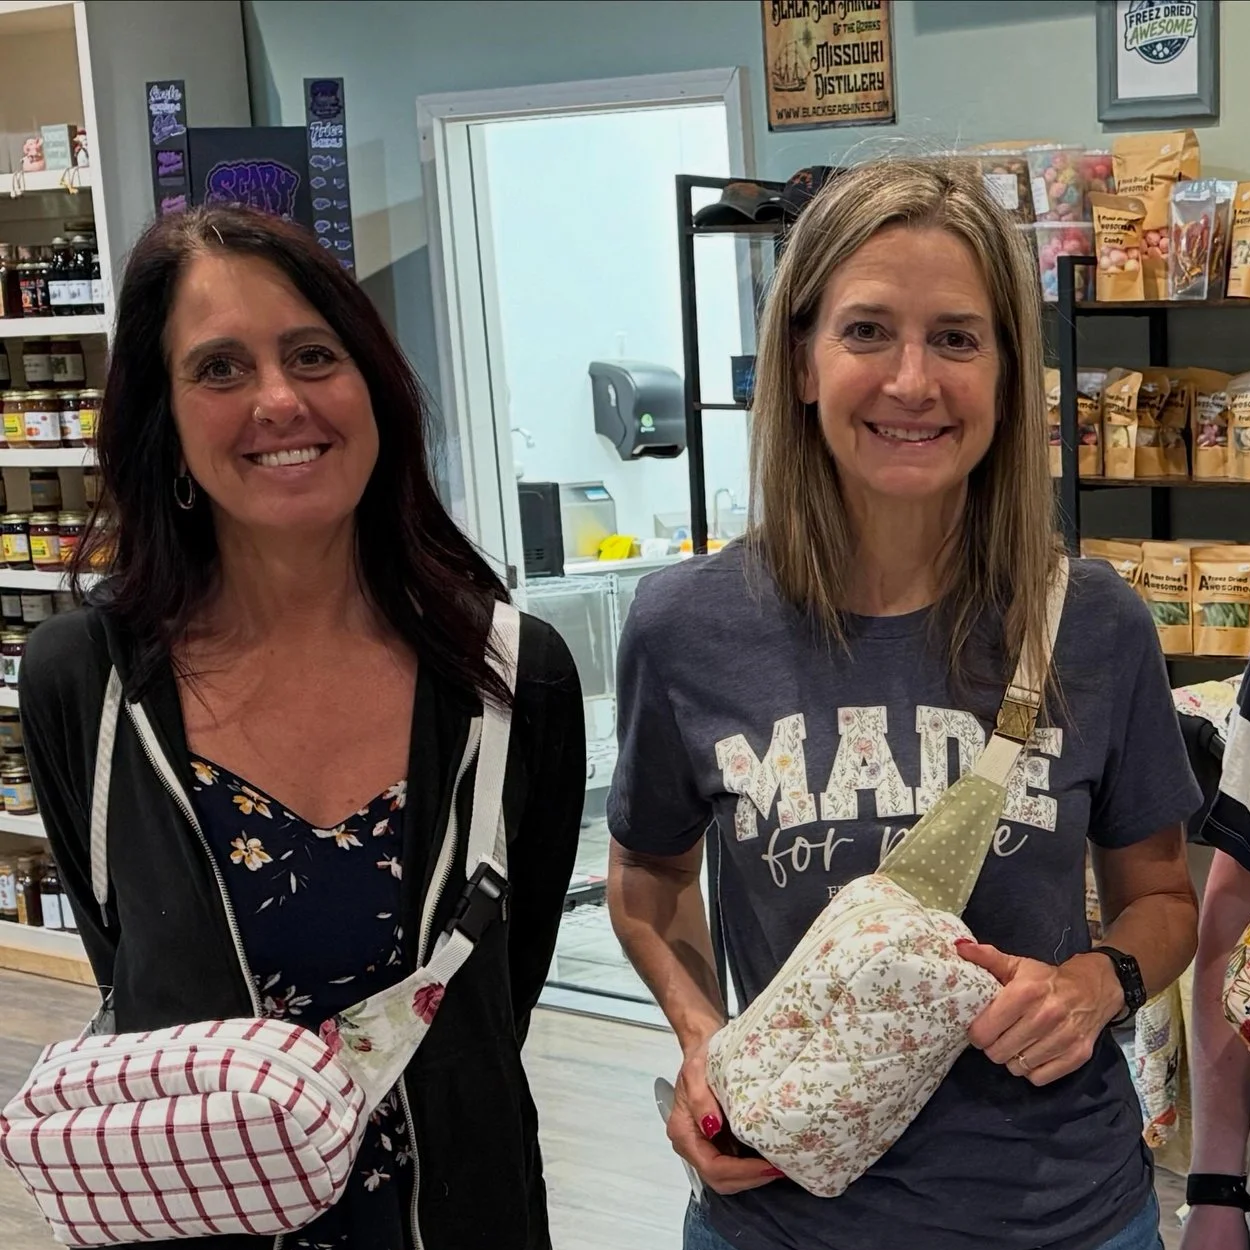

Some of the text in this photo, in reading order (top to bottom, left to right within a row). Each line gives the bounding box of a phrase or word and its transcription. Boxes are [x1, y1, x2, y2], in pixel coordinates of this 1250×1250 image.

[833, 22, 842, 36] OF
[1129, 5, 1192, 28] FREEZ DRIED
[1129, 18, 1194, 45] AWESOME
[810, 40, 884, 73] MISSOURI
[814, 72, 884, 100] DISTILLERY
[776, 100, 889, 120] WWW.BLACKSEASHINES.COM
[1103, 236, 1123, 245] Candy
[715, 705, 1063, 842] MADE
[761, 827, 855, 889] for
